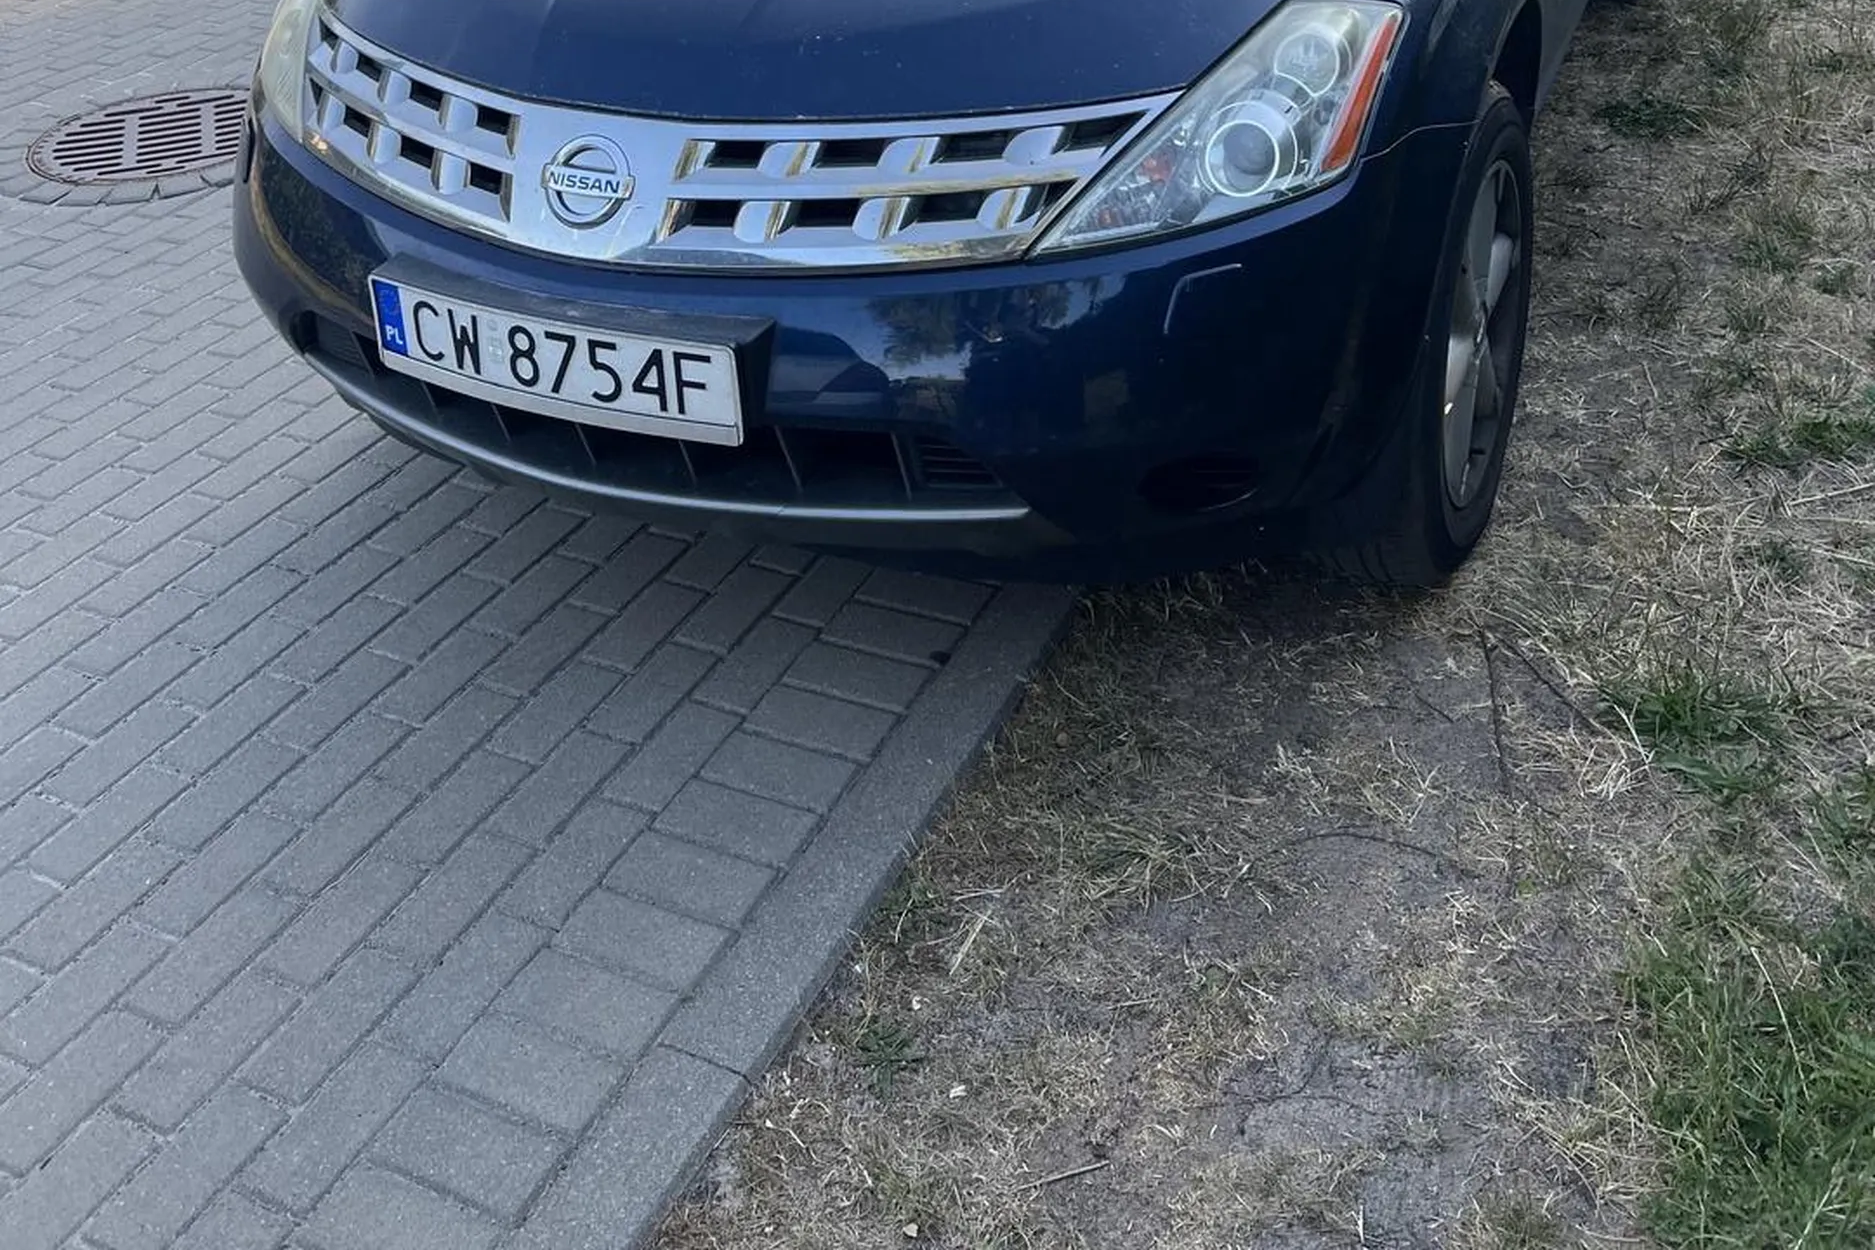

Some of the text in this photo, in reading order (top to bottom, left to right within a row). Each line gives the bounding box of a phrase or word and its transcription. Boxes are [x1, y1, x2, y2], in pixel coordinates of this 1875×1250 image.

[547, 171, 620, 194] NISSAN
[385, 324, 404, 345] PL
[412, 300, 711, 415] CW 8754F
